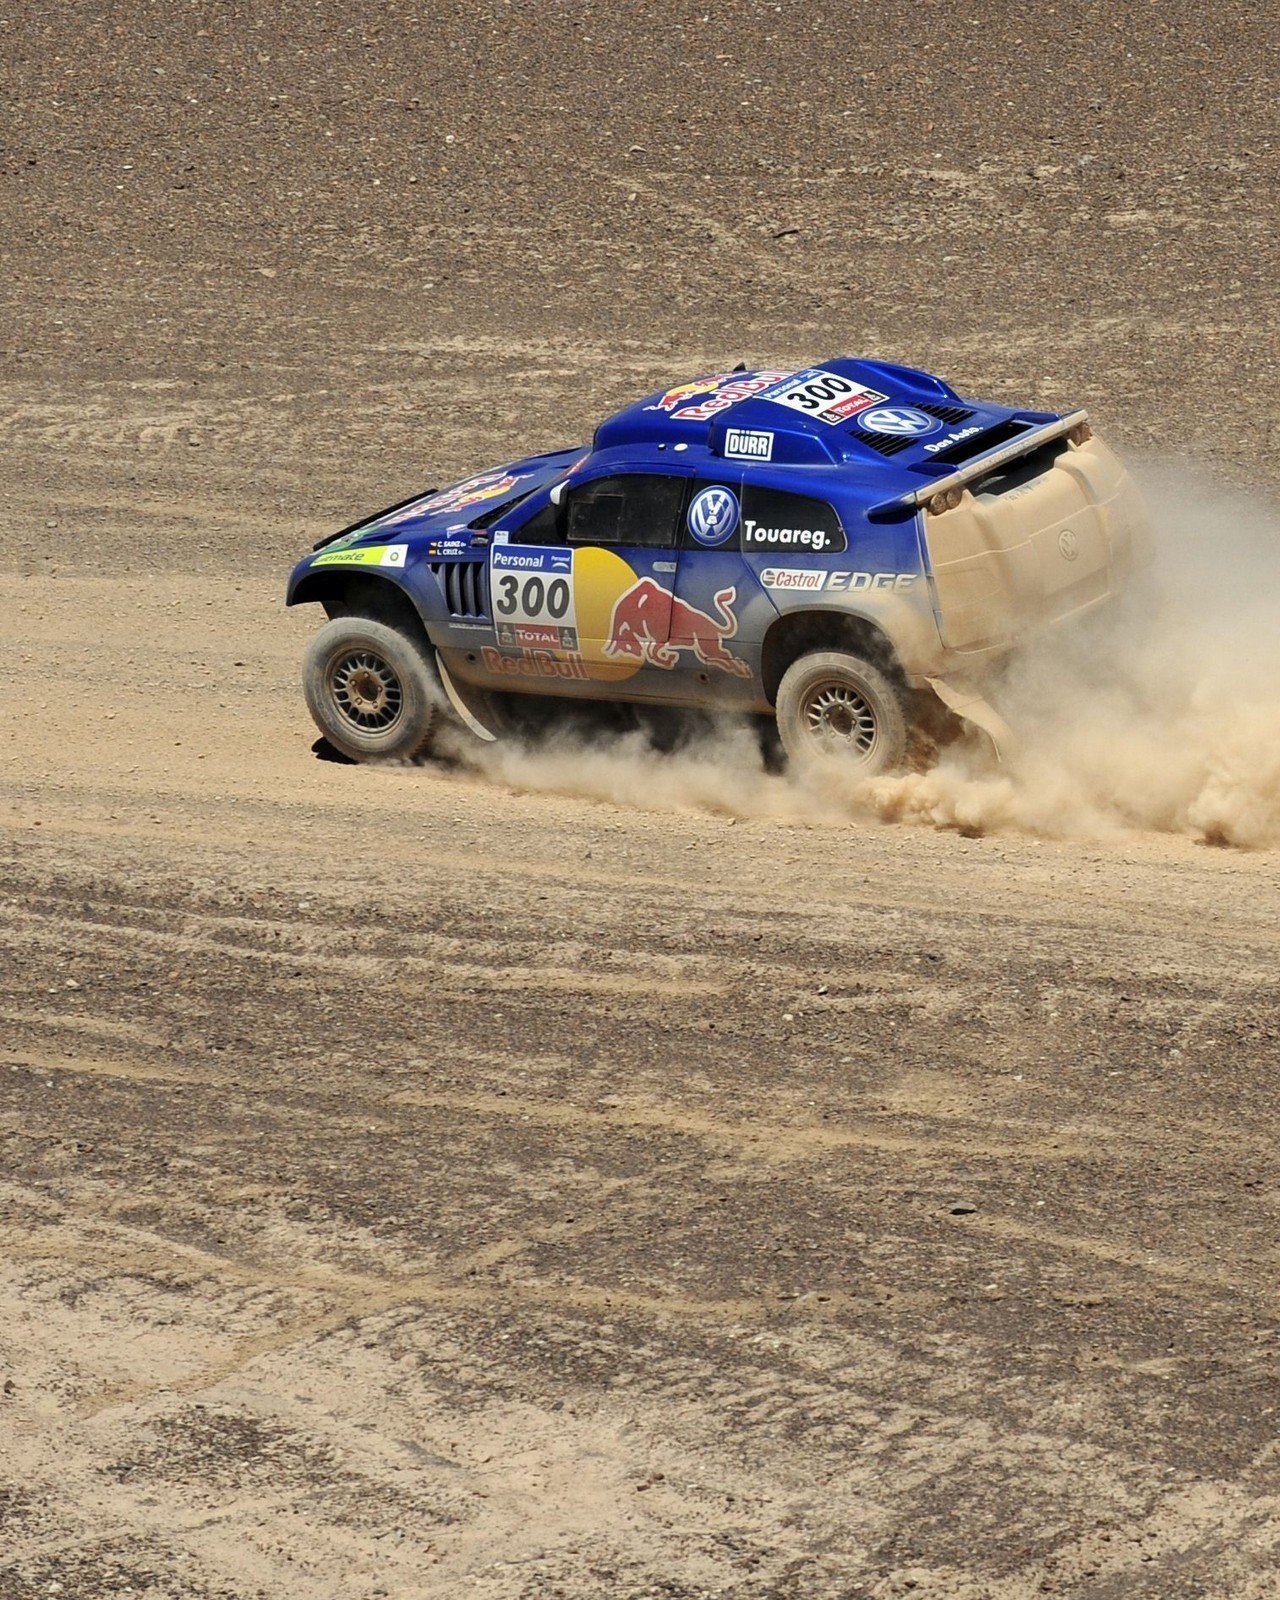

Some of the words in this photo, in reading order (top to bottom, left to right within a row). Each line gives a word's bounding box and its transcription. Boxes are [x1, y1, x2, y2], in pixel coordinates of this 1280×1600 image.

[787, 377, 852, 410] 300
[834, 395, 869, 414] TOTAL
[728, 429, 768, 456] DÜRR
[923, 438, 952, 454] Das
[744, 520, 831, 551] Touareg.
[494, 553, 544, 567] Personal
[775, 571, 822, 589] Castrol
[824, 571, 918, 593] EDGE
[496, 575, 570, 619] 300
[516, 629, 559, 643] TOTAL
